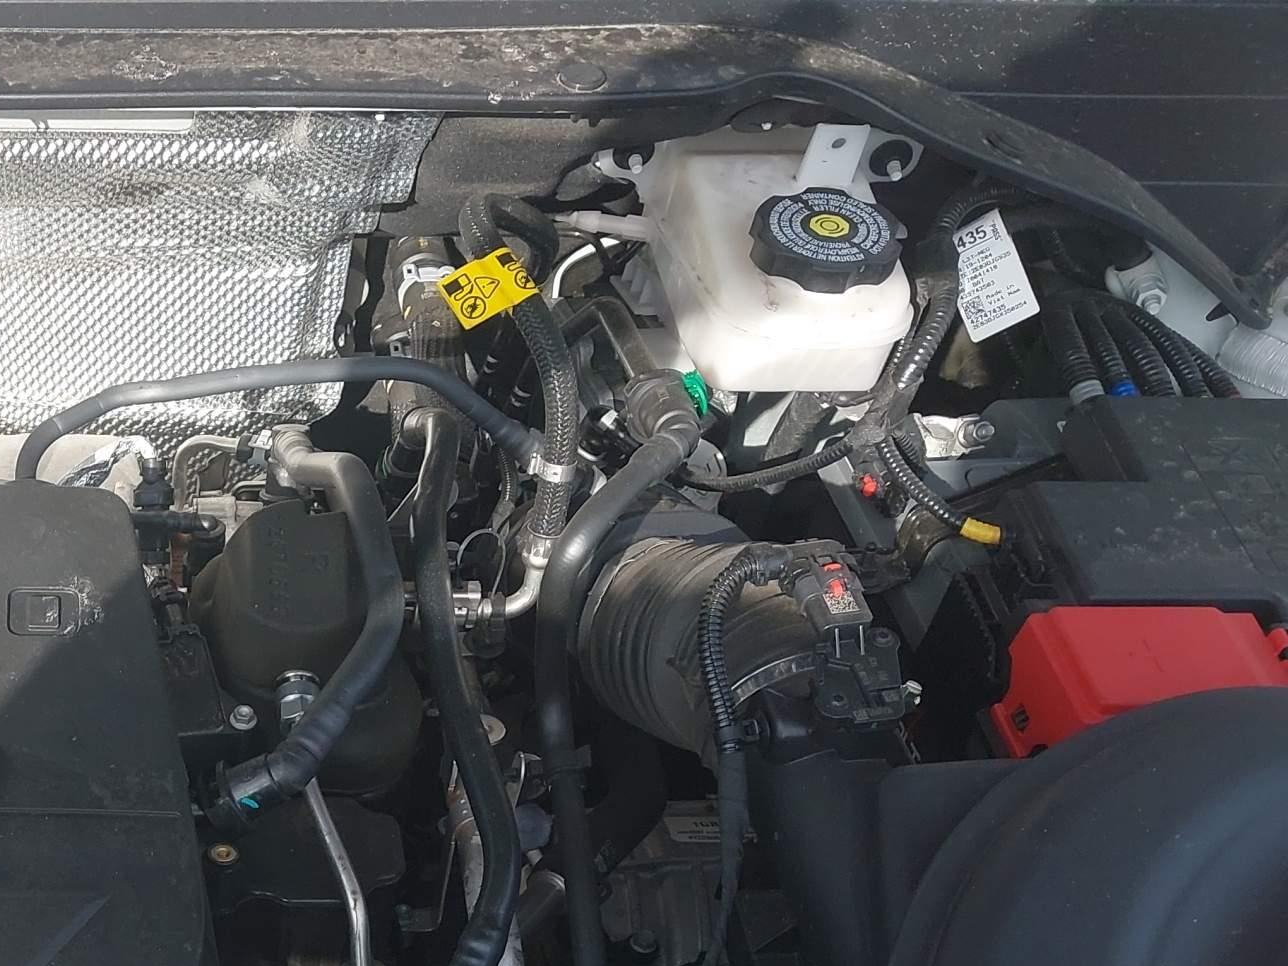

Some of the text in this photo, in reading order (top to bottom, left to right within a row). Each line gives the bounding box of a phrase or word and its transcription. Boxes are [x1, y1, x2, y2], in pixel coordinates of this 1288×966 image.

[957, 224, 987, 249] 435
[985, 289, 1001, 299] Made
[988, 296, 1004, 304] Viet
